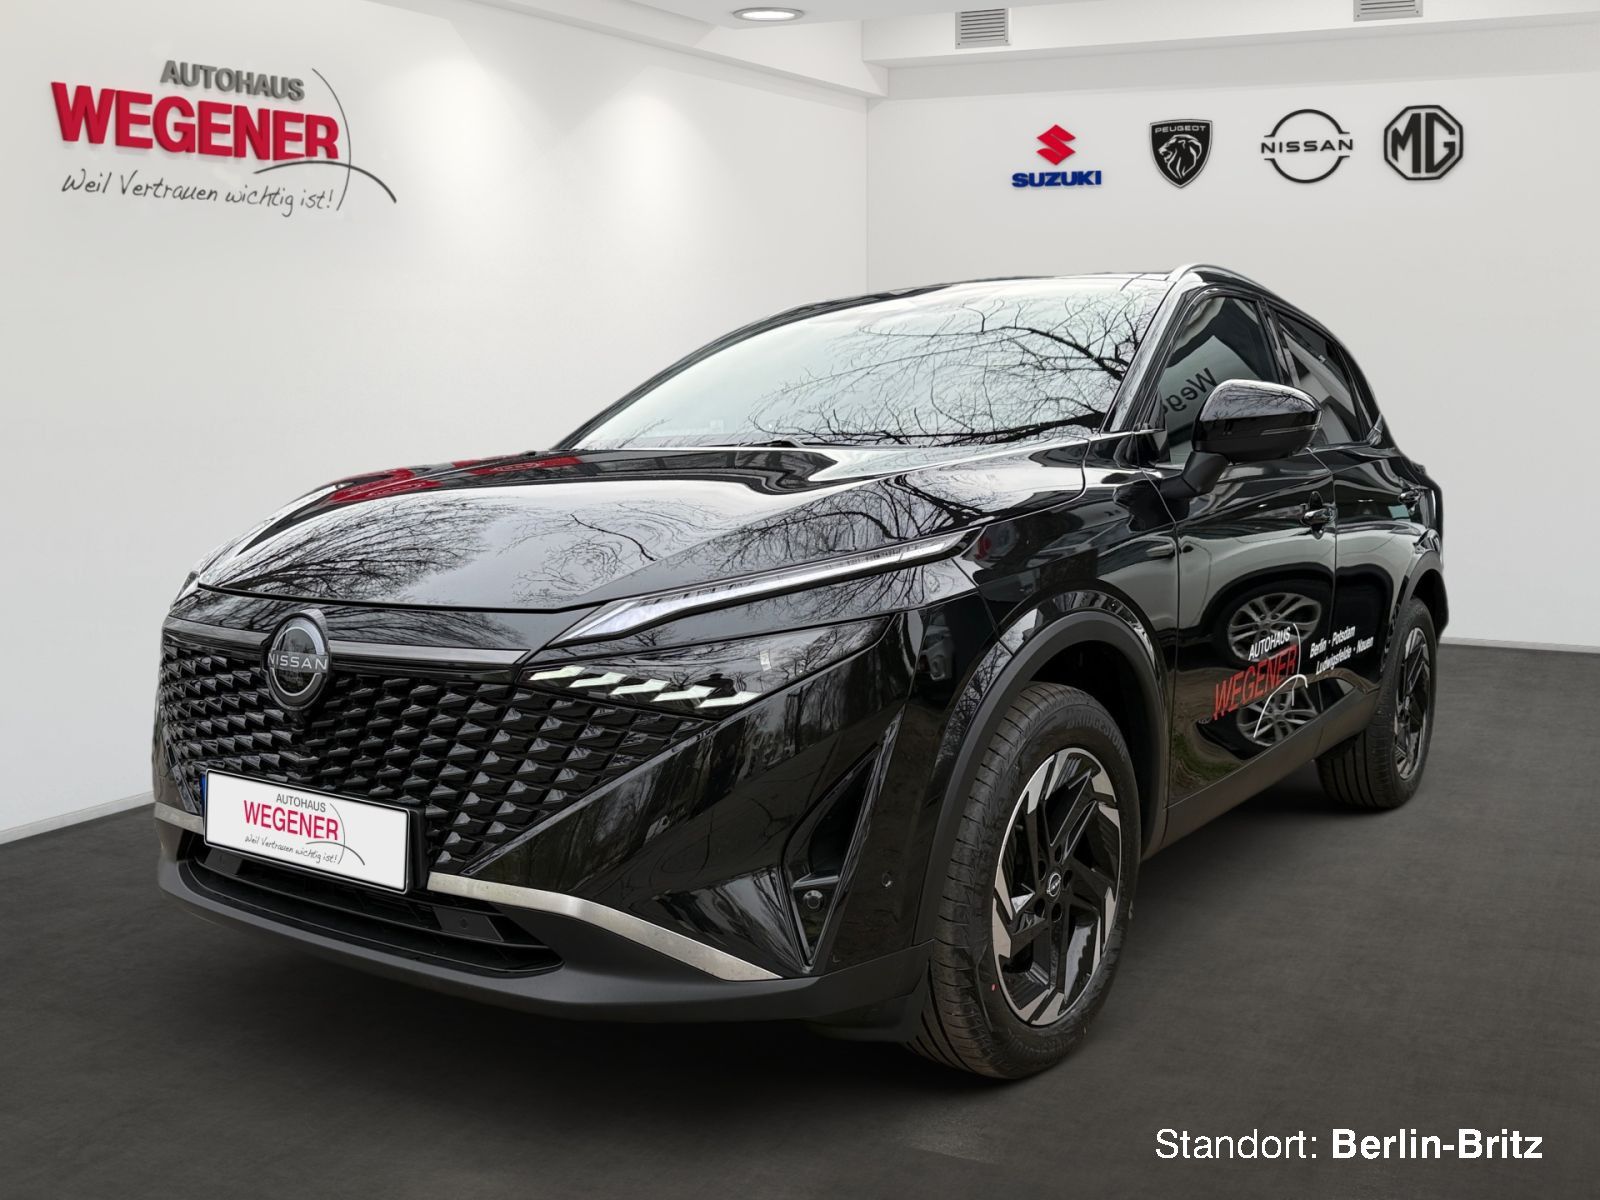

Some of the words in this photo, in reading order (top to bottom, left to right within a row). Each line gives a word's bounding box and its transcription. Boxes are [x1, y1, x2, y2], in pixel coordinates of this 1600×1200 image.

[160, 60, 305, 101] AUTOHAUS
[51, 81, 339, 161] WEGENER
[1154, 125, 1207, 133] PEUGEOT
[1261, 139, 1353, 154] NISSAN
[1391, 112, 1456, 174] MG
[61, 168, 112, 193] Weil
[120, 169, 218, 202] Vertrauen
[225, 184, 294, 217] wichtig
[300, 189, 334, 209] ist!
[1011, 170, 1102, 188] SUZUKI
[1248, 626, 1291, 661] AUTOHAUS
[1310, 638, 1327, 658] Berlin
[268, 653, 328, 670] NISSAN
[1213, 644, 1298, 720] WEGENER
[276, 793, 326, 813] AUTOHAUS
[243, 800, 339, 840] WEGENER
[244, 834, 260, 845] Weil
[261, 835, 294, 853] Vertrauen
